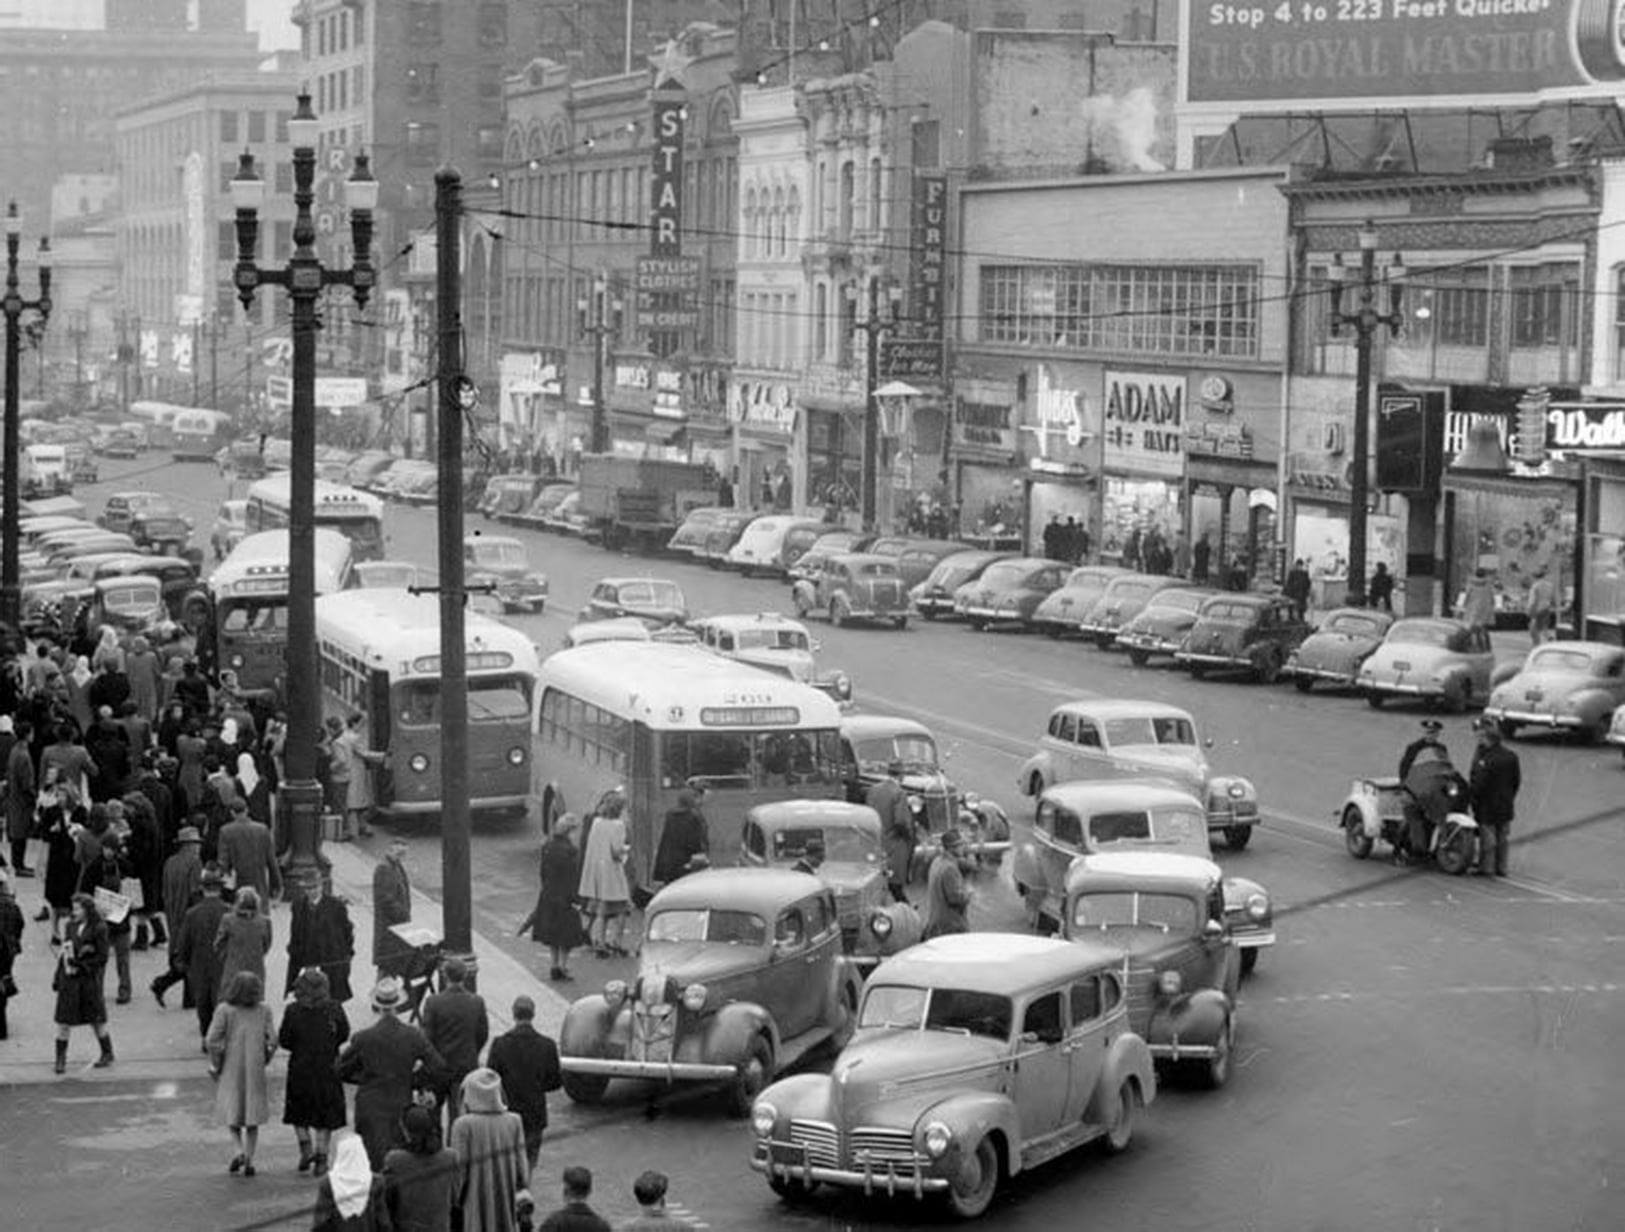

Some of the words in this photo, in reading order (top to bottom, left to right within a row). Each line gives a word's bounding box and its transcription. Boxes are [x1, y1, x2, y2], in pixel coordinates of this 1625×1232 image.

[1209, 3, 1264, 29] Stop
[1274, 1, 1292, 22] 4
[1302, 2, 1327, 22] to
[1337, 0, 1382, 20] 223
[1393, 0, 1447, 18] Feet
[1271, 37, 1388, 79] ROYAL
[1402, 29, 1555, 75] MASTER
[659, 110, 678, 243] STAR
[639, 260, 698, 273] STYLISH
[639, 275, 698, 289] CLOTHES
[1106, 381, 1182, 427] ADAM
